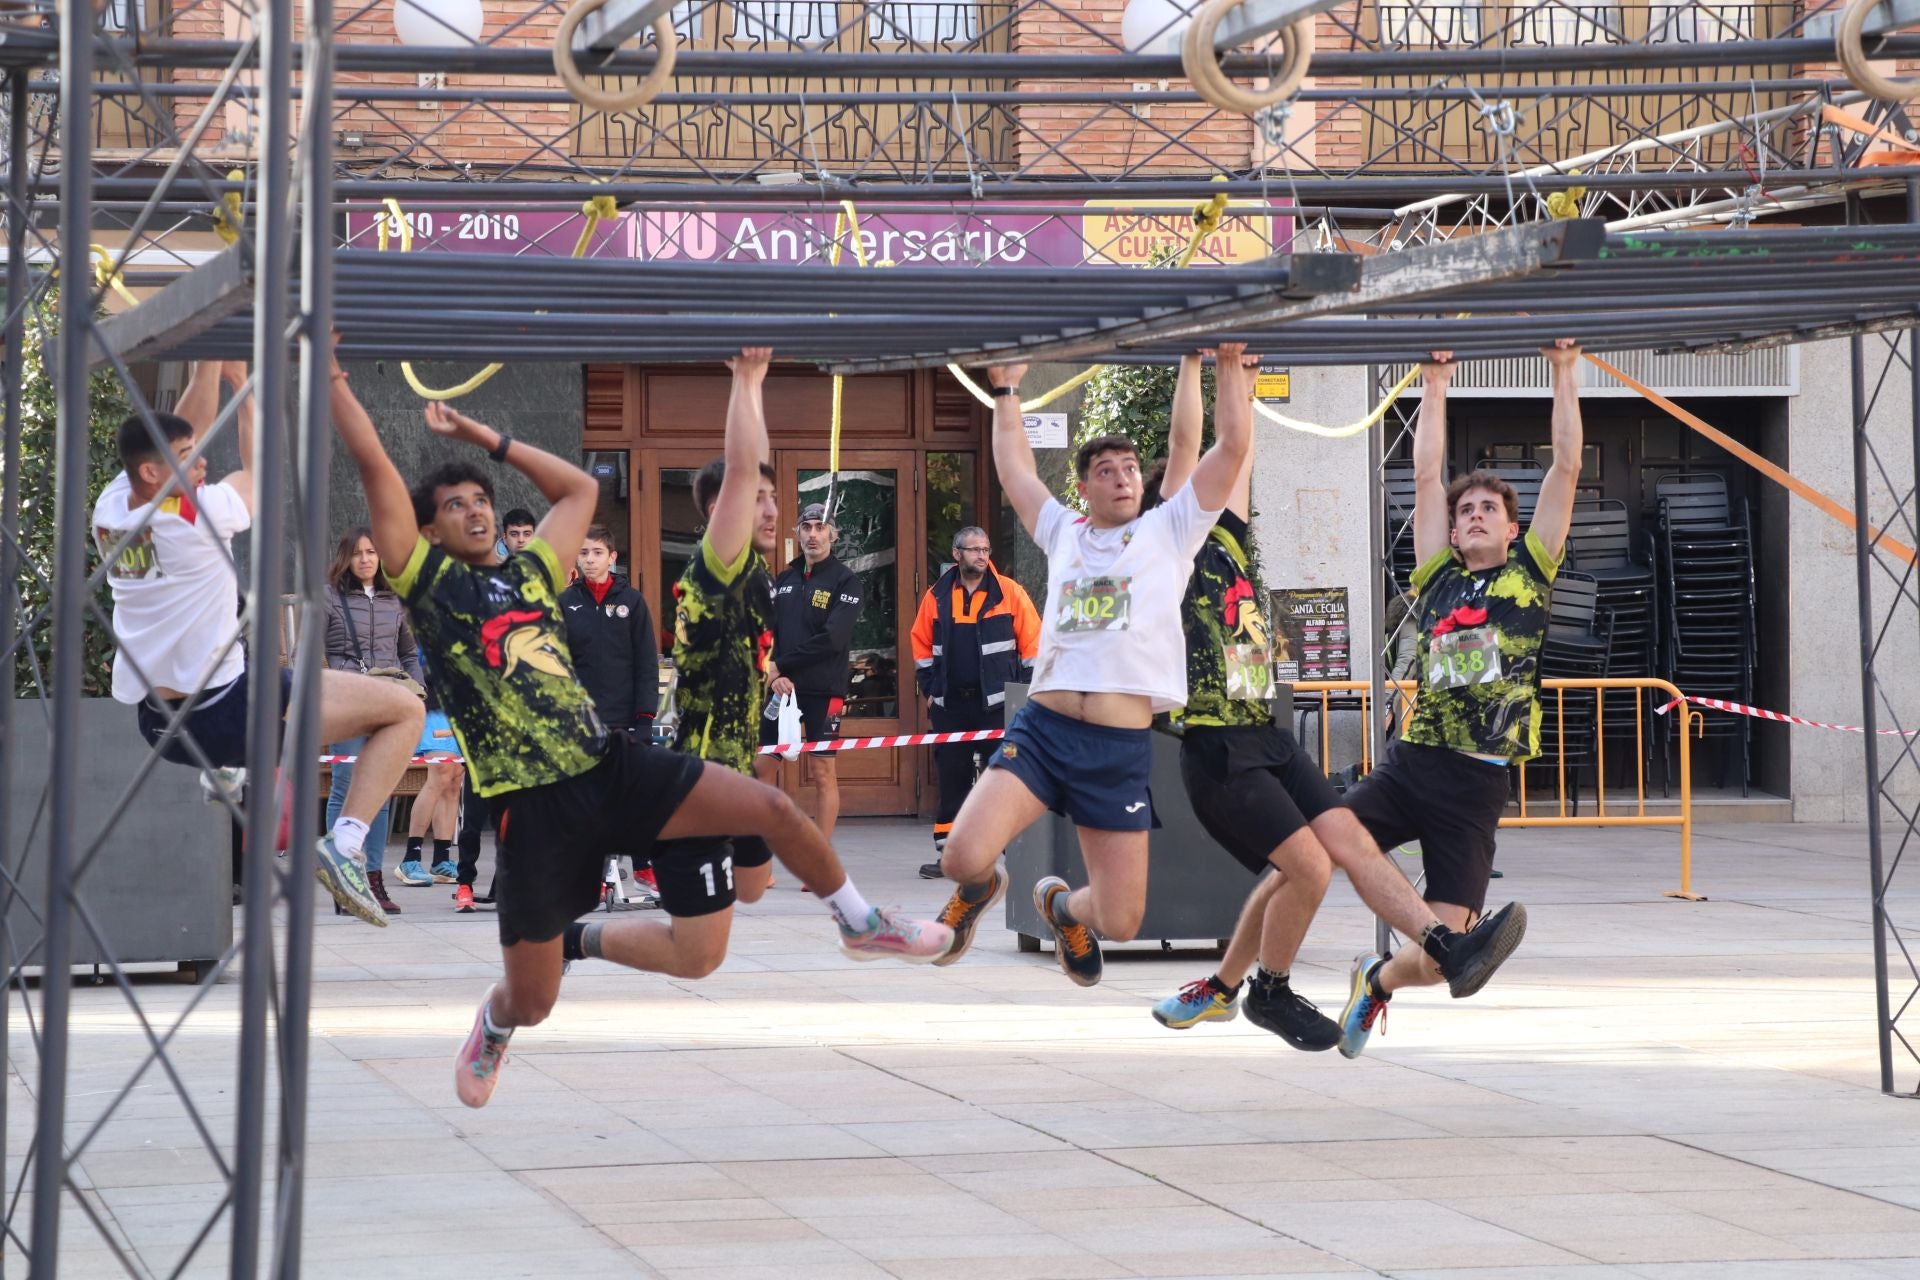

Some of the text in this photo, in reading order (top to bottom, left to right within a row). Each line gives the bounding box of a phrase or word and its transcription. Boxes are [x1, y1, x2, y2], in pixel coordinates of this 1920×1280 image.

[458, 213, 519, 240] 2010
[617, 206, 717, 260] 100
[1104, 212, 1252, 233] ASOCIAON
[114, 546, 147, 568] 01
[1072, 596, 1115, 620] 102
[1290, 602, 1346, 615] SANTA CECILIA
[1441, 650, 1485, 677] 138
[1237, 664, 1268, 688] 139
[698, 855, 734, 897] 11
